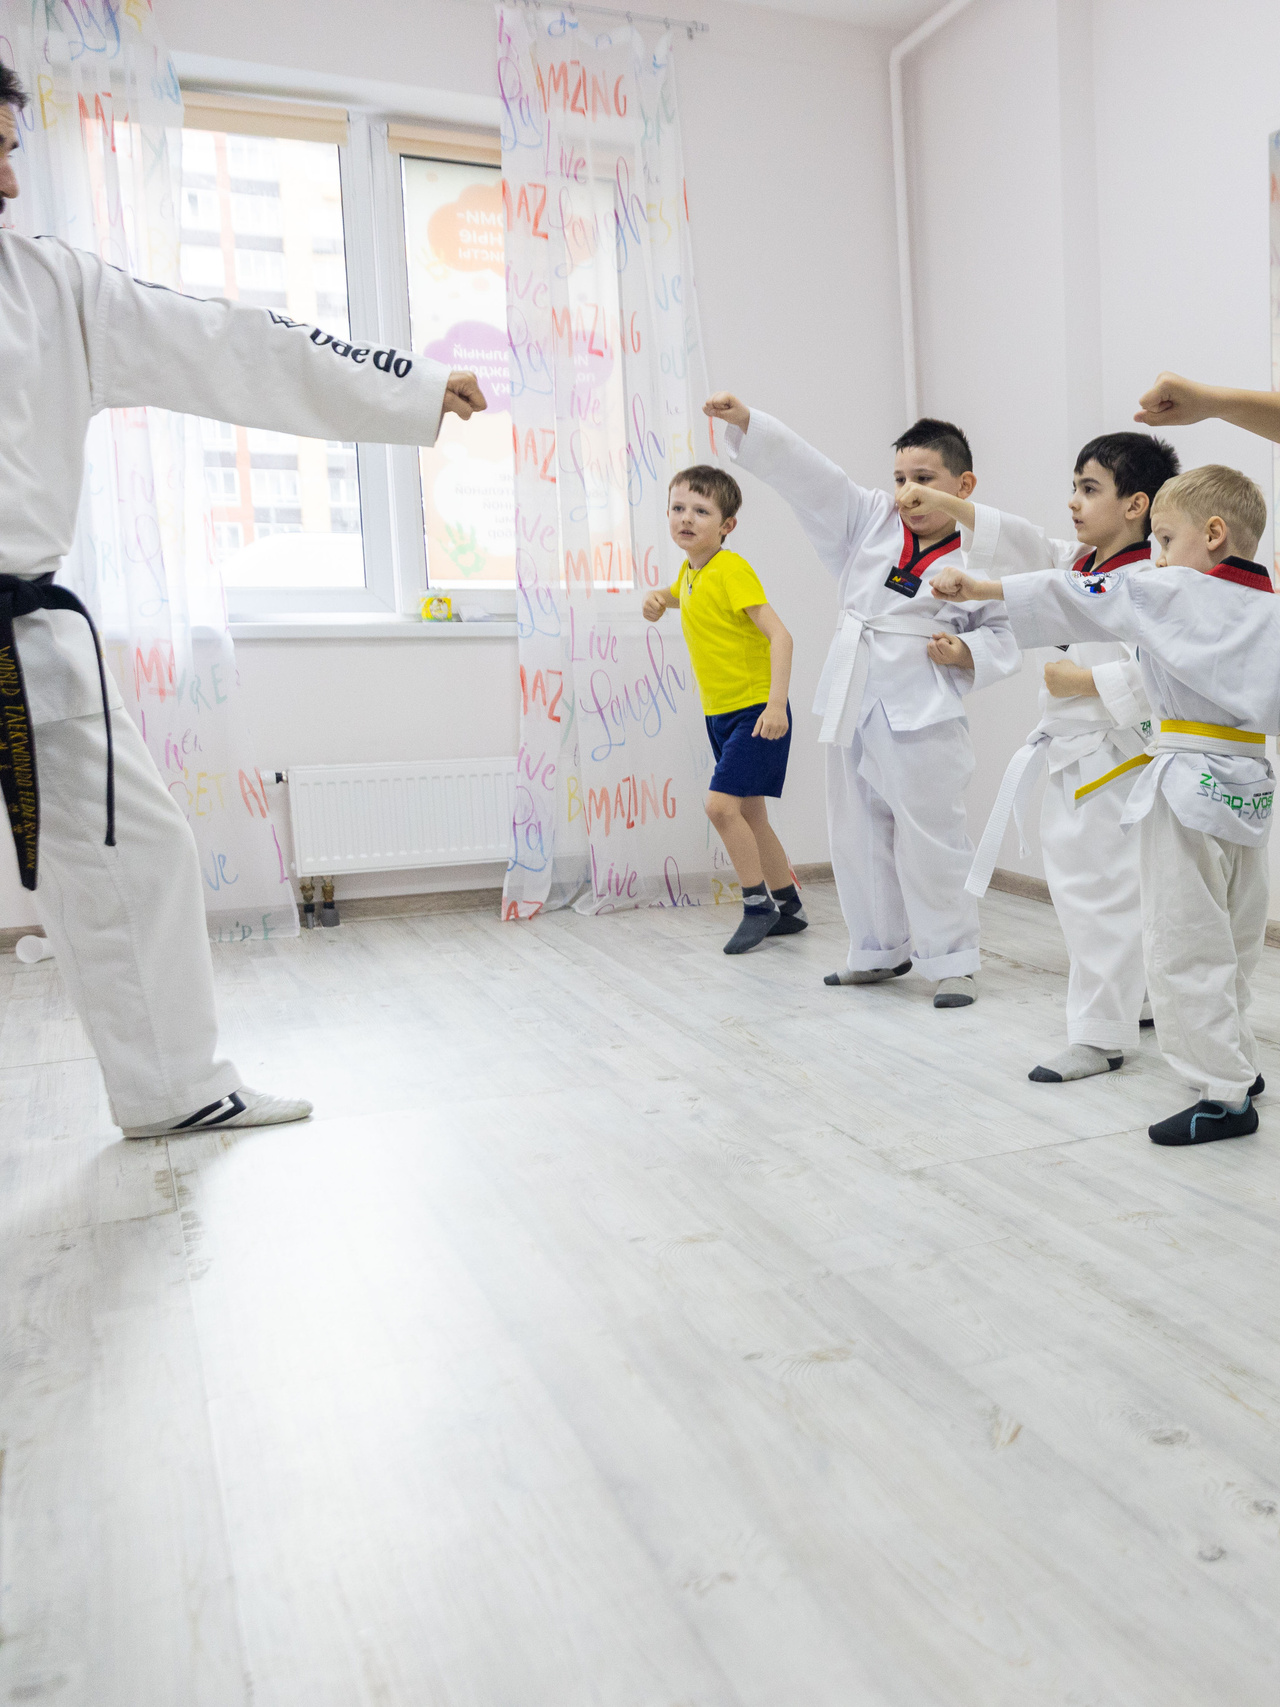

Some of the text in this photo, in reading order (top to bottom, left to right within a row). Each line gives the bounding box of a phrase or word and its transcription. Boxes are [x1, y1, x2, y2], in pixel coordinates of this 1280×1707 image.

[570, 605, 619, 664] Live
[0, 645, 21, 697] WORLD
[579, 625, 686, 761] Laugh
[3, 704, 33, 787] TAEKWONDO
[18, 790, 37, 870] FEDERATION
[590, 843, 638, 899] Live
